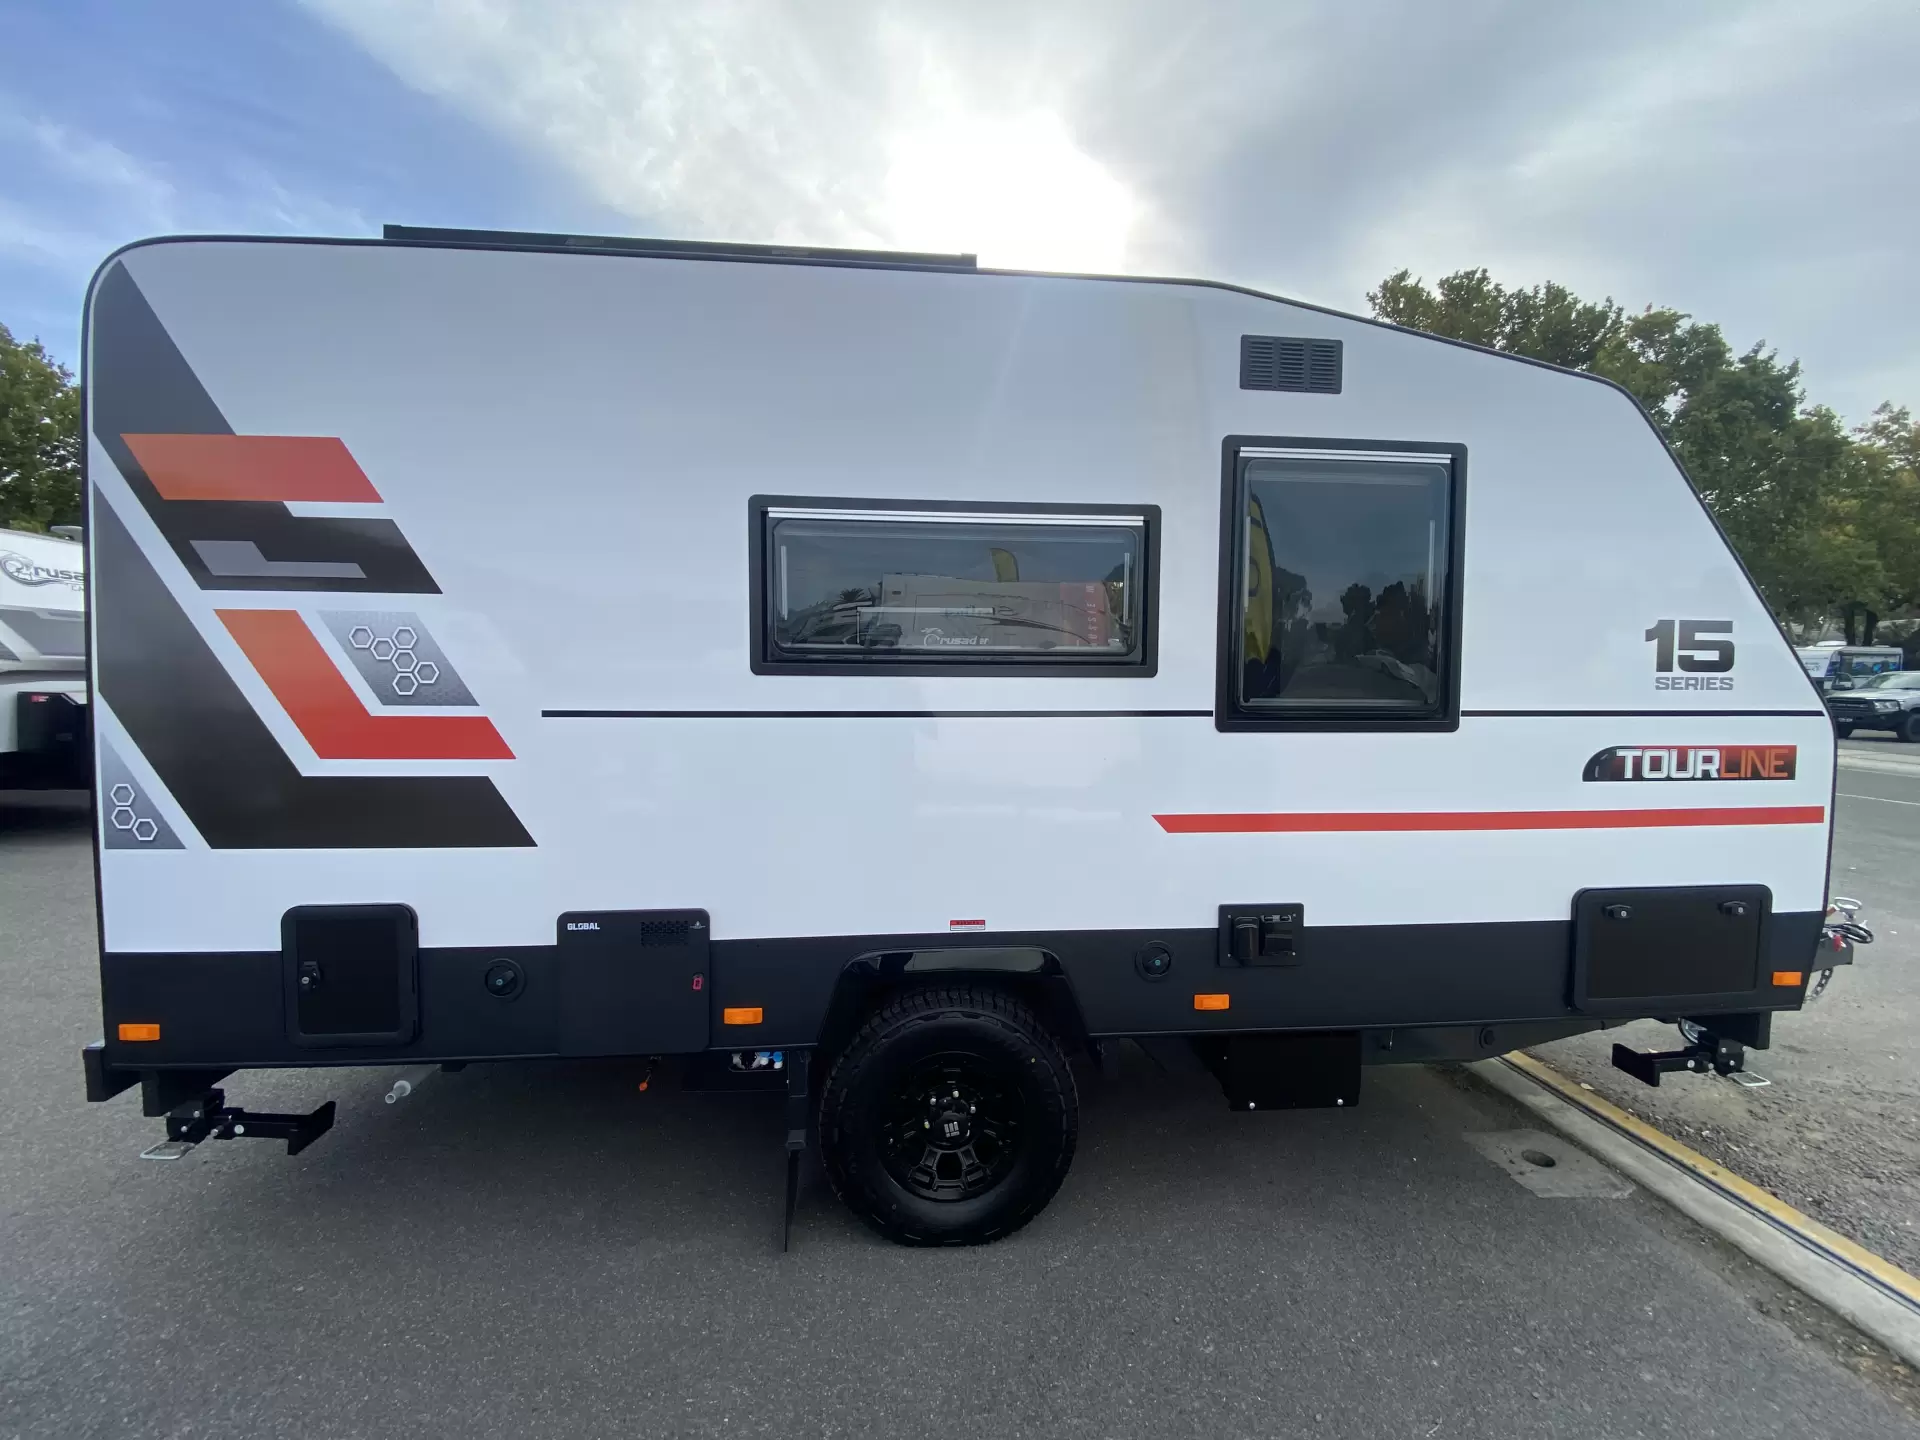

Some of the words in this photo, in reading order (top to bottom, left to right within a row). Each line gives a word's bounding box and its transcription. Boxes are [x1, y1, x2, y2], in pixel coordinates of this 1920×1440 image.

[1645, 620, 1735, 672] 15
[1655, 677, 1734, 690] SERIES
[1616, 749, 1789, 778] TOURLINE
[567, 922, 600, 930] GLOBAL
